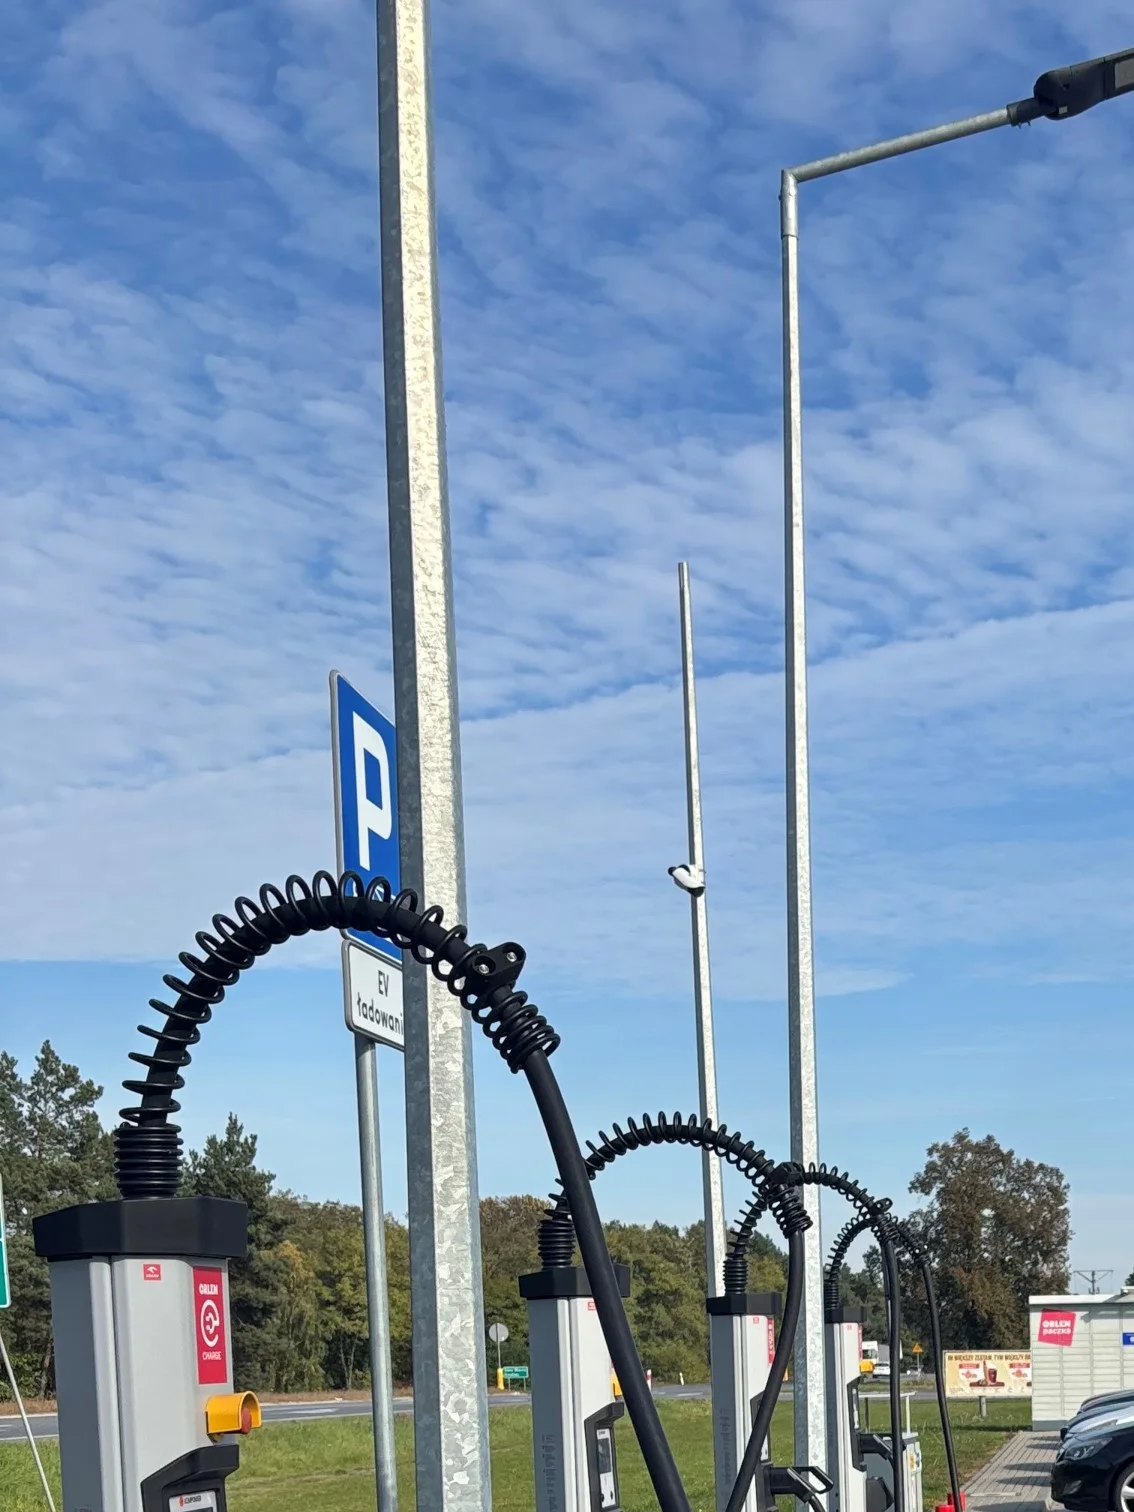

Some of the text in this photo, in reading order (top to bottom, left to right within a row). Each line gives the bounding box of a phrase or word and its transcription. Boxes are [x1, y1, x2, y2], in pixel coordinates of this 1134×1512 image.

[352, 710, 393, 871] P
[378, 969, 389, 997] EV
[199, 1283, 219, 1296] ORLEN
[1042, 1320, 1072, 1328] ORLEN
[202, 1351, 222, 1361] CHARGE
